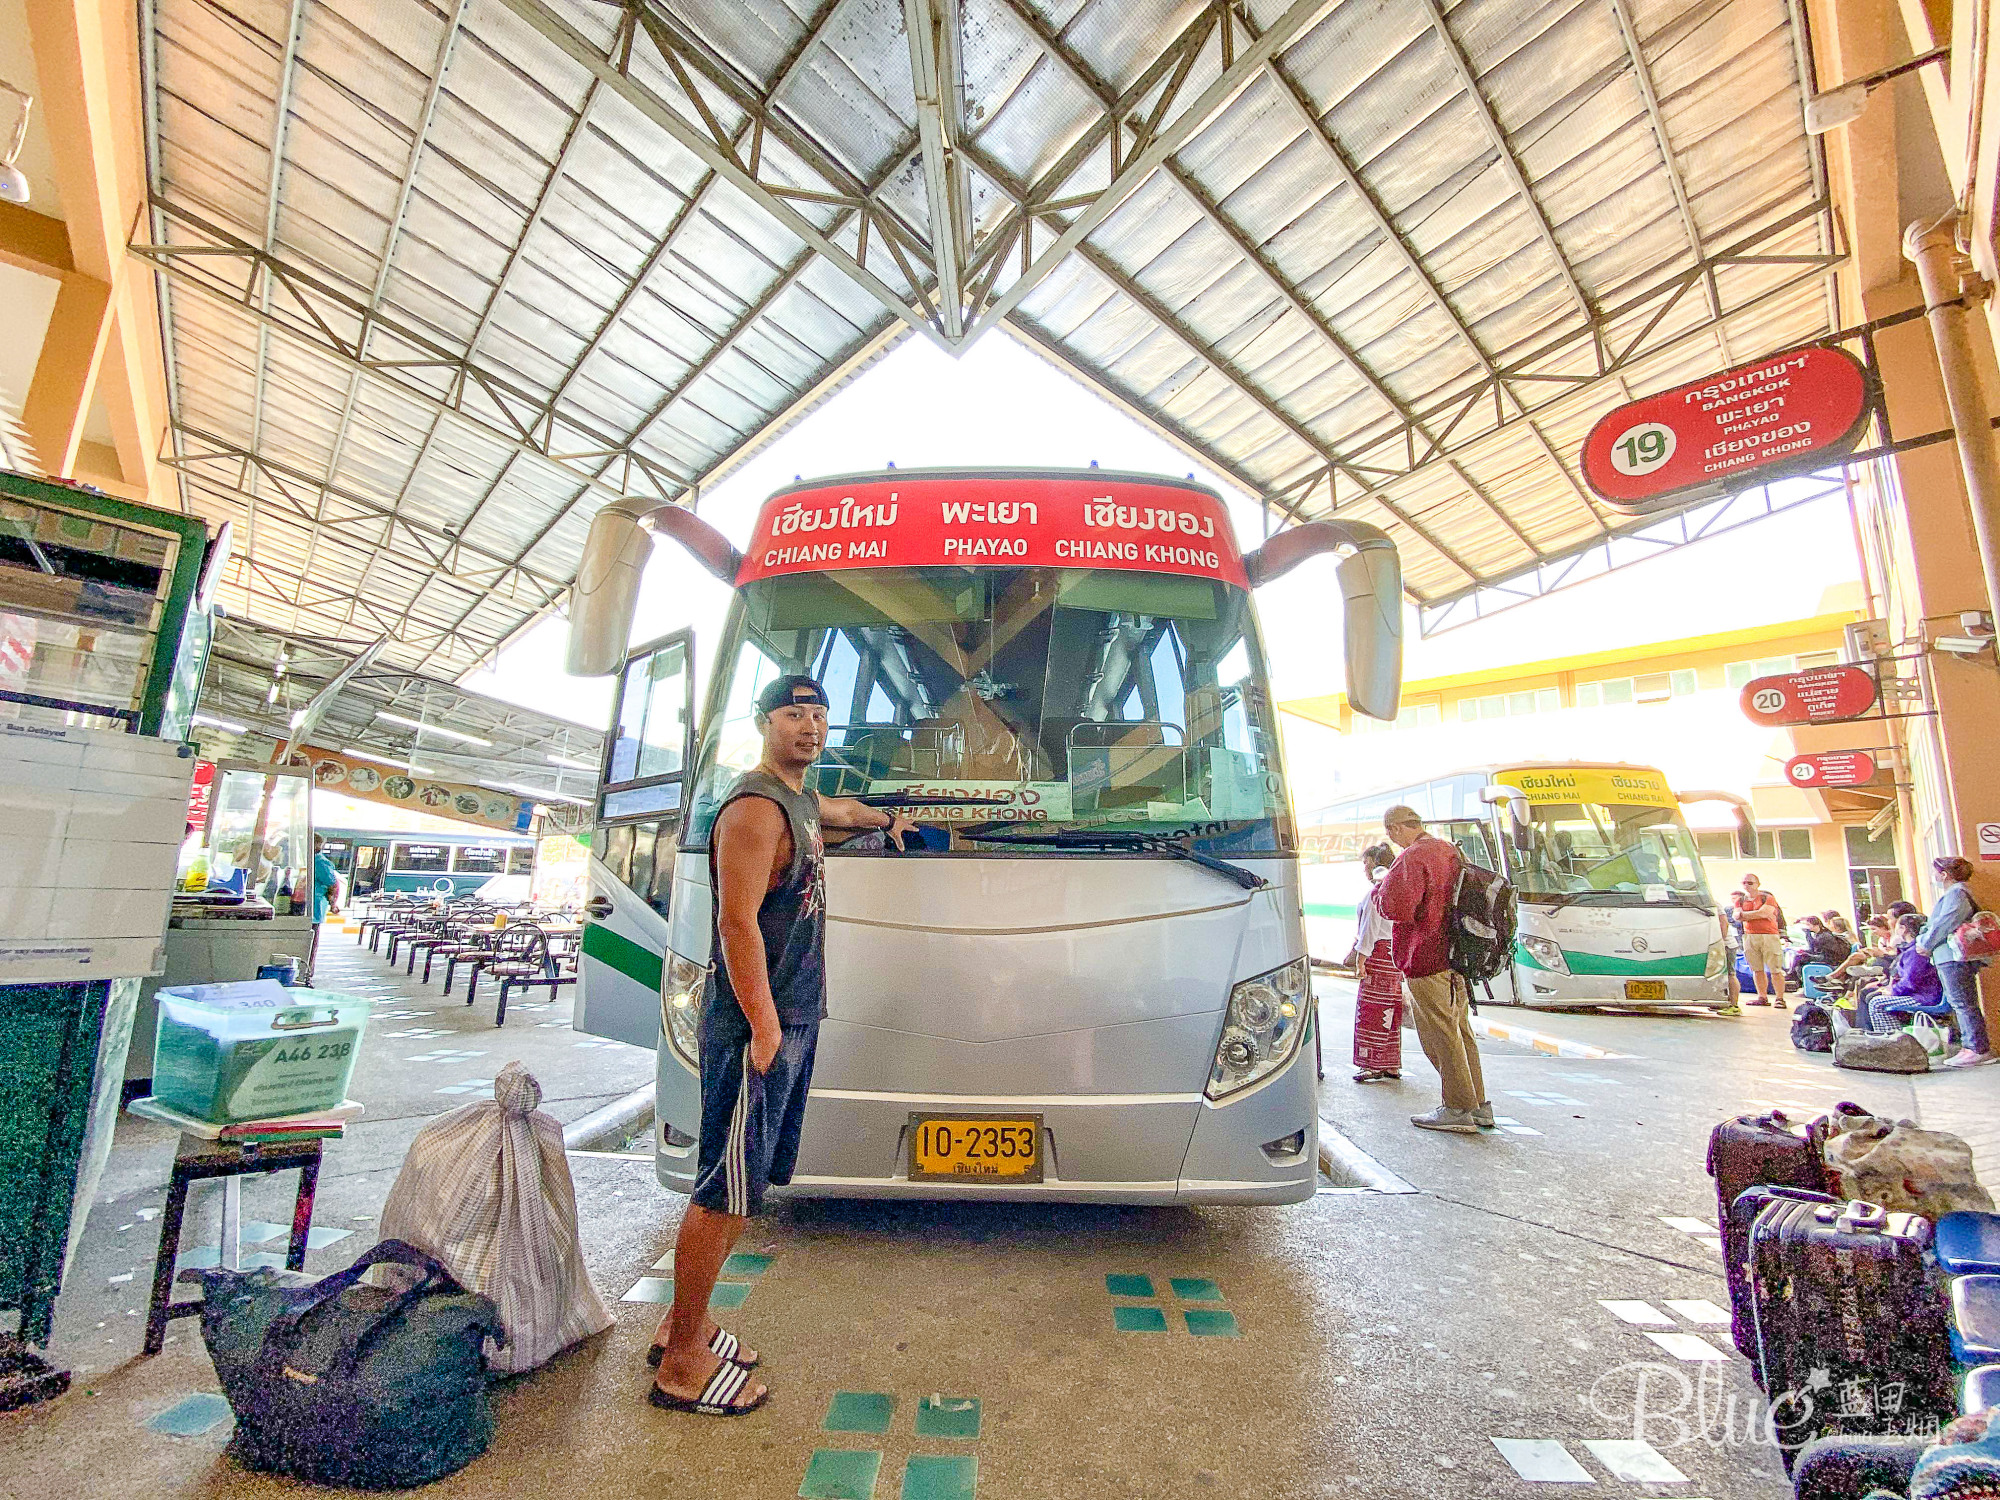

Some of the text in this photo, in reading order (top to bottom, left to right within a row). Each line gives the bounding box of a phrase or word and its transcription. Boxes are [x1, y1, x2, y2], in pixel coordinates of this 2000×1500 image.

[1685, 354, 1809, 405] กรุงเทพฯ
[1702, 378, 1791, 411] BANGKOK
[1715, 395, 1786, 426] พะเยา
[1723, 412, 1780, 435] PHAYAO
[1616, 430, 1667, 468] 19
[1704, 421, 1811, 460] เชียงของ
[1704, 437, 1813, 473] CHIANG KHONG
[771, 492, 1215, 538] เชียงใหม่ พะเยา เชียงของ
[764, 538, 1220, 569] CHIANG MAI PHAYAO CHIANG KHONG
[1756, 692, 1782, 709] 20
[1520, 773, 1660, 791] เชียงใหม่ เชียงราย
[1795, 766, 1811, 777] 21
[1563, 792, 1581, 800] MAI
[1617, 792, 1650, 801] CHIANG
[1650, 794, 1665, 803] RAI
[971, 808, 1048, 821] KHONG
[923, 1126, 1034, 1157] 10-2353
[953, 1162, 999, 1174] เชียงใหม่
